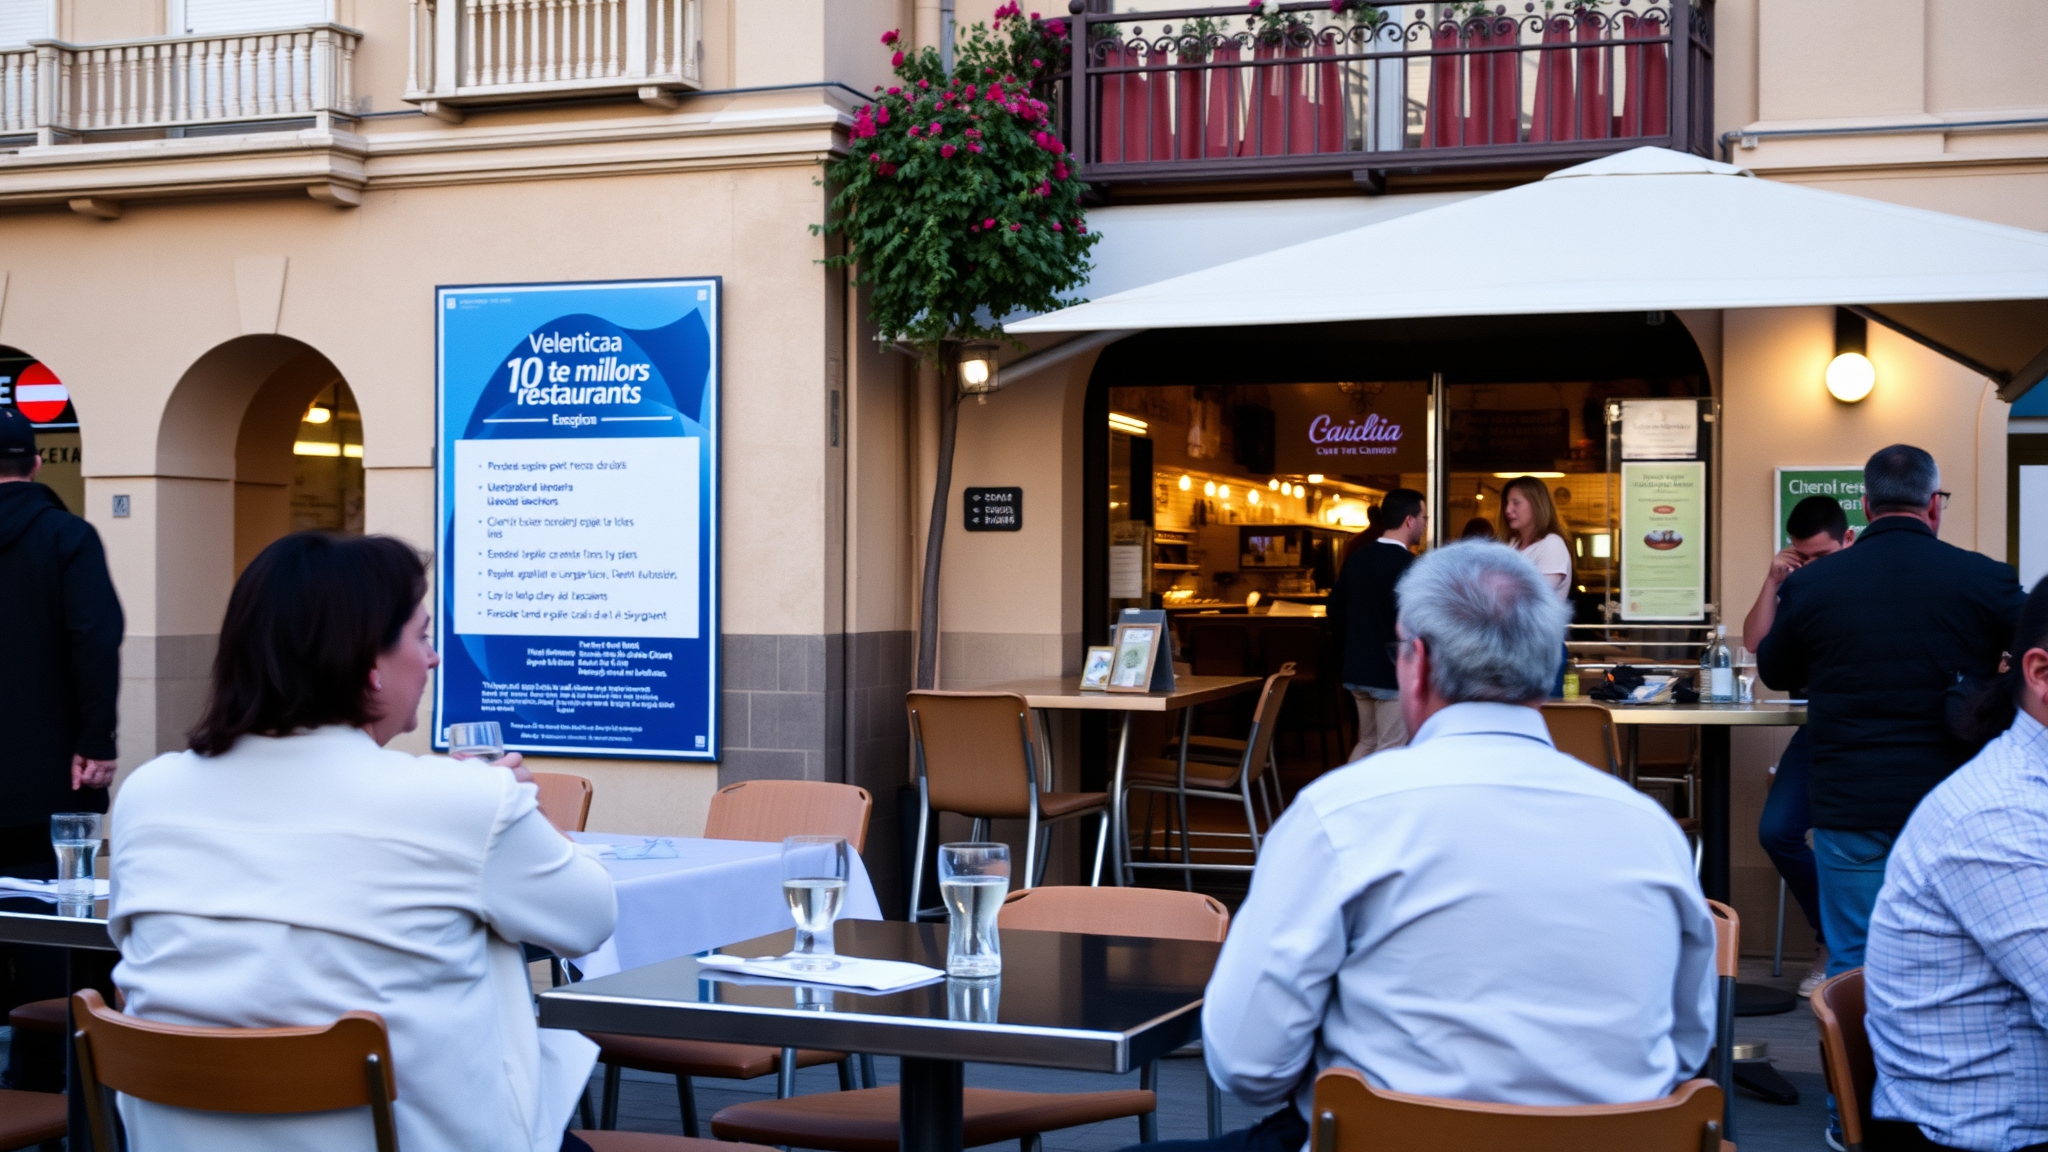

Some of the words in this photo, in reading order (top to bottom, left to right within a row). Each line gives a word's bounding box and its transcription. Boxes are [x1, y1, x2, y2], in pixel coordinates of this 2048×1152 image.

[529, 331, 622, 354] Velerticaa
[508, 357, 543, 393] 10
[547, 361, 571, 382] te
[575, 356, 651, 382] millors
[517, 383, 642, 406] restaurants
